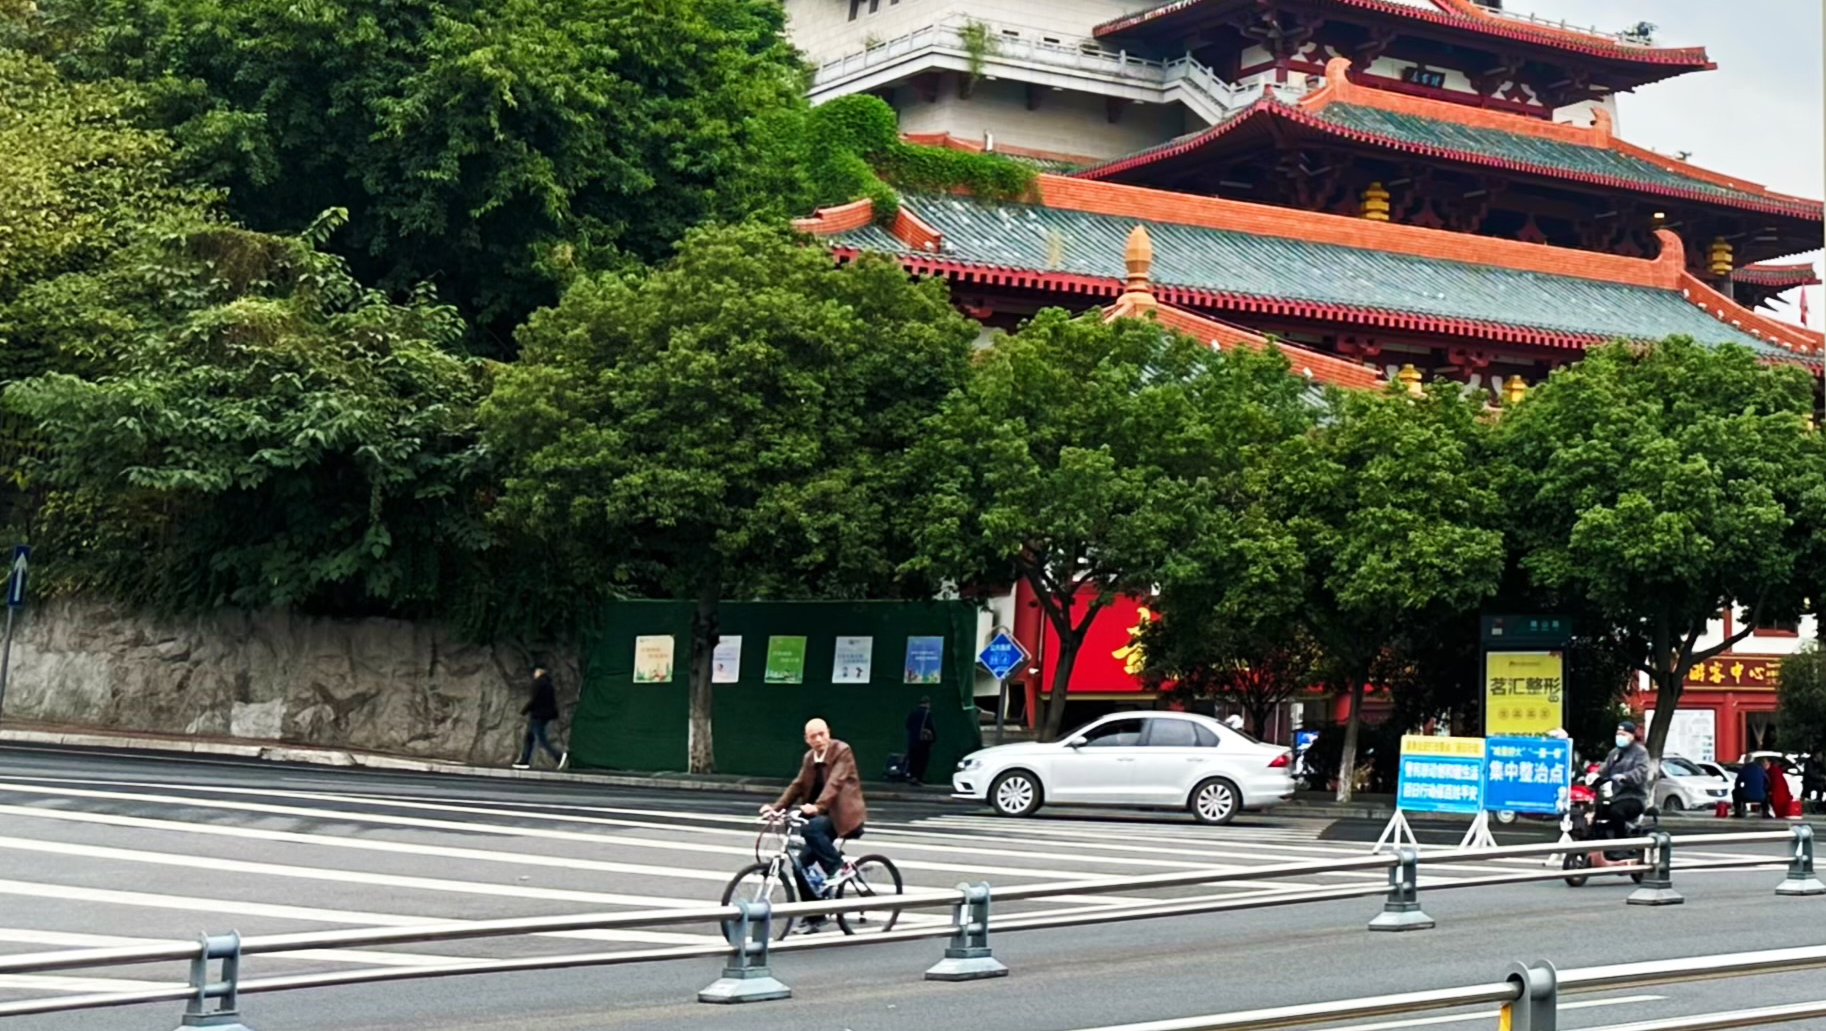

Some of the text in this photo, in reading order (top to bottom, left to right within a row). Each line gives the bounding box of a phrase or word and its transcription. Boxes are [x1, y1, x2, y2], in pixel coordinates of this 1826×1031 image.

[1489, 761, 1565, 784] 集中整治点
